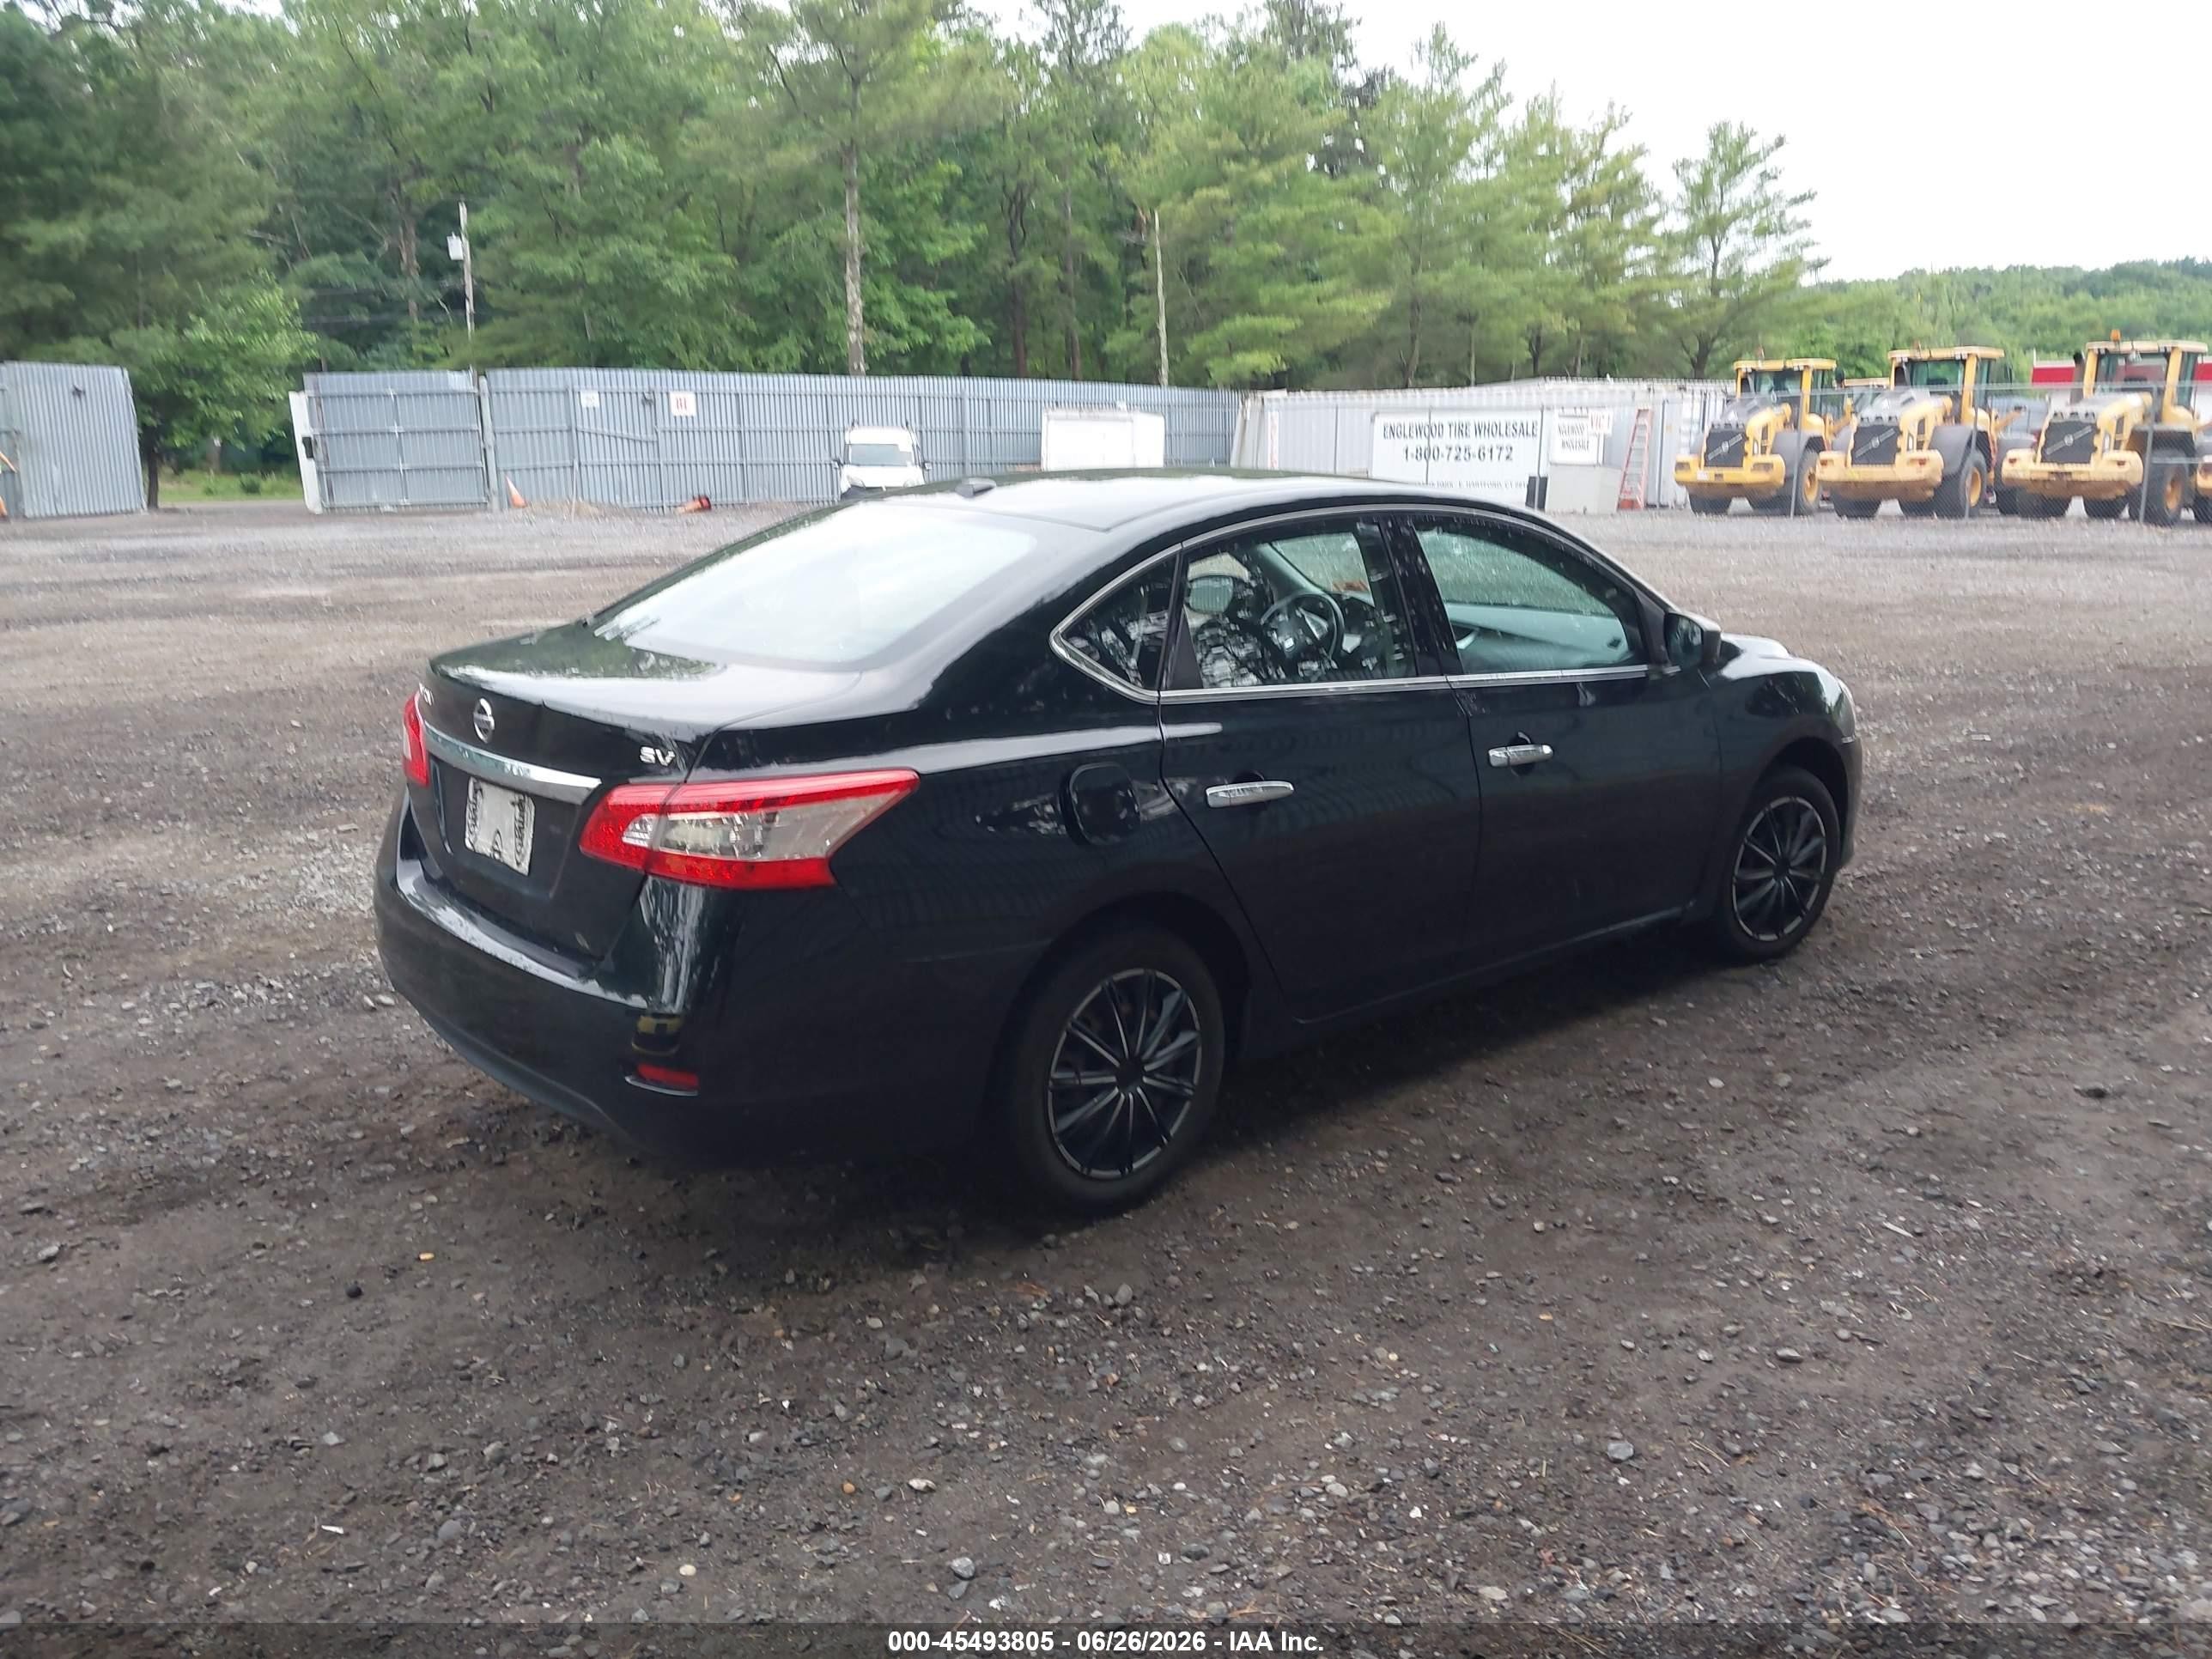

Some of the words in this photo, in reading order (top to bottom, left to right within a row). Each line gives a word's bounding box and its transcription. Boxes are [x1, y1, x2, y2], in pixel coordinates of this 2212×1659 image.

[1383, 422, 1444, 440] ENGLEWOOD
[1448, 421, 1471, 439] TIRE
[1474, 420, 1538, 440] WHOLESALE
[1404, 444, 1514, 462] 1-800-725-6172
[640, 746, 675, 766] SV
